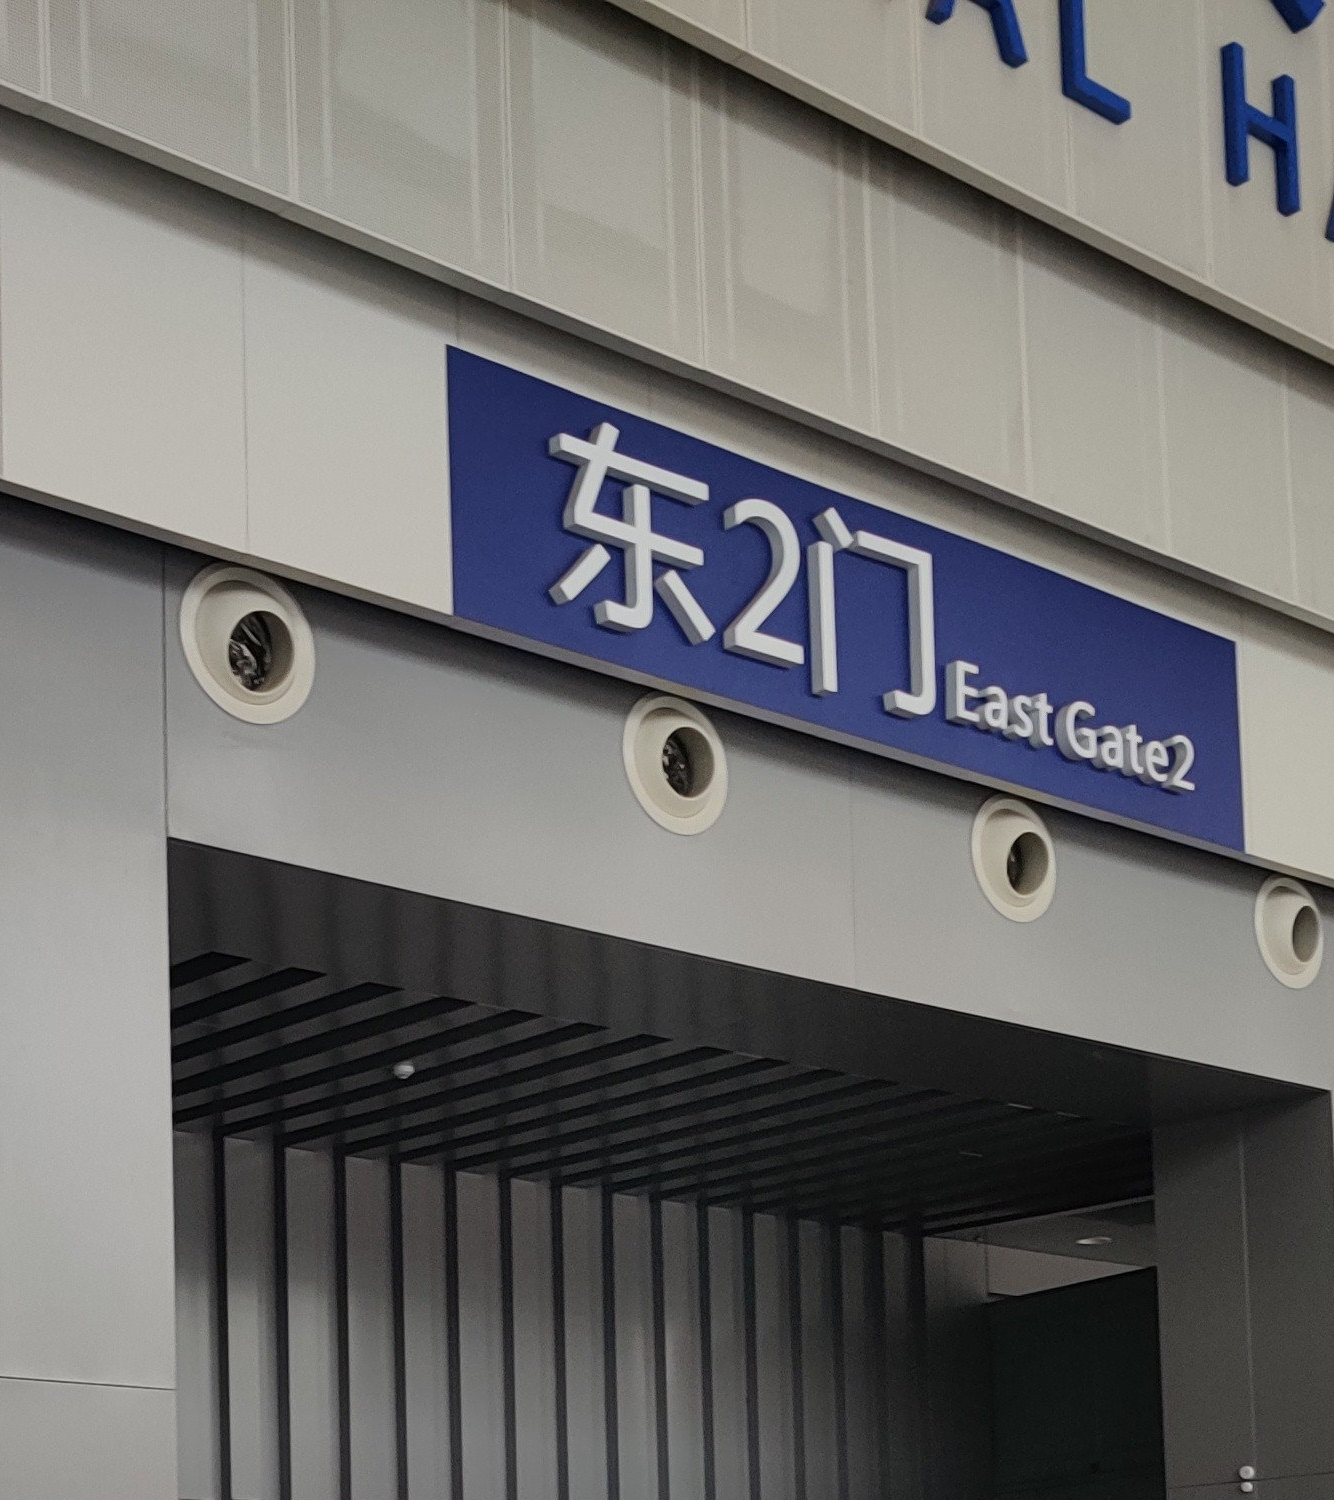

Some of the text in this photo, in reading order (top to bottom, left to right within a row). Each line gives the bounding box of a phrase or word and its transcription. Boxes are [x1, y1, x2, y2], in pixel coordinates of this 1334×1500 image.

[548, 421, 1195, 791] 东2门 East Gate2
